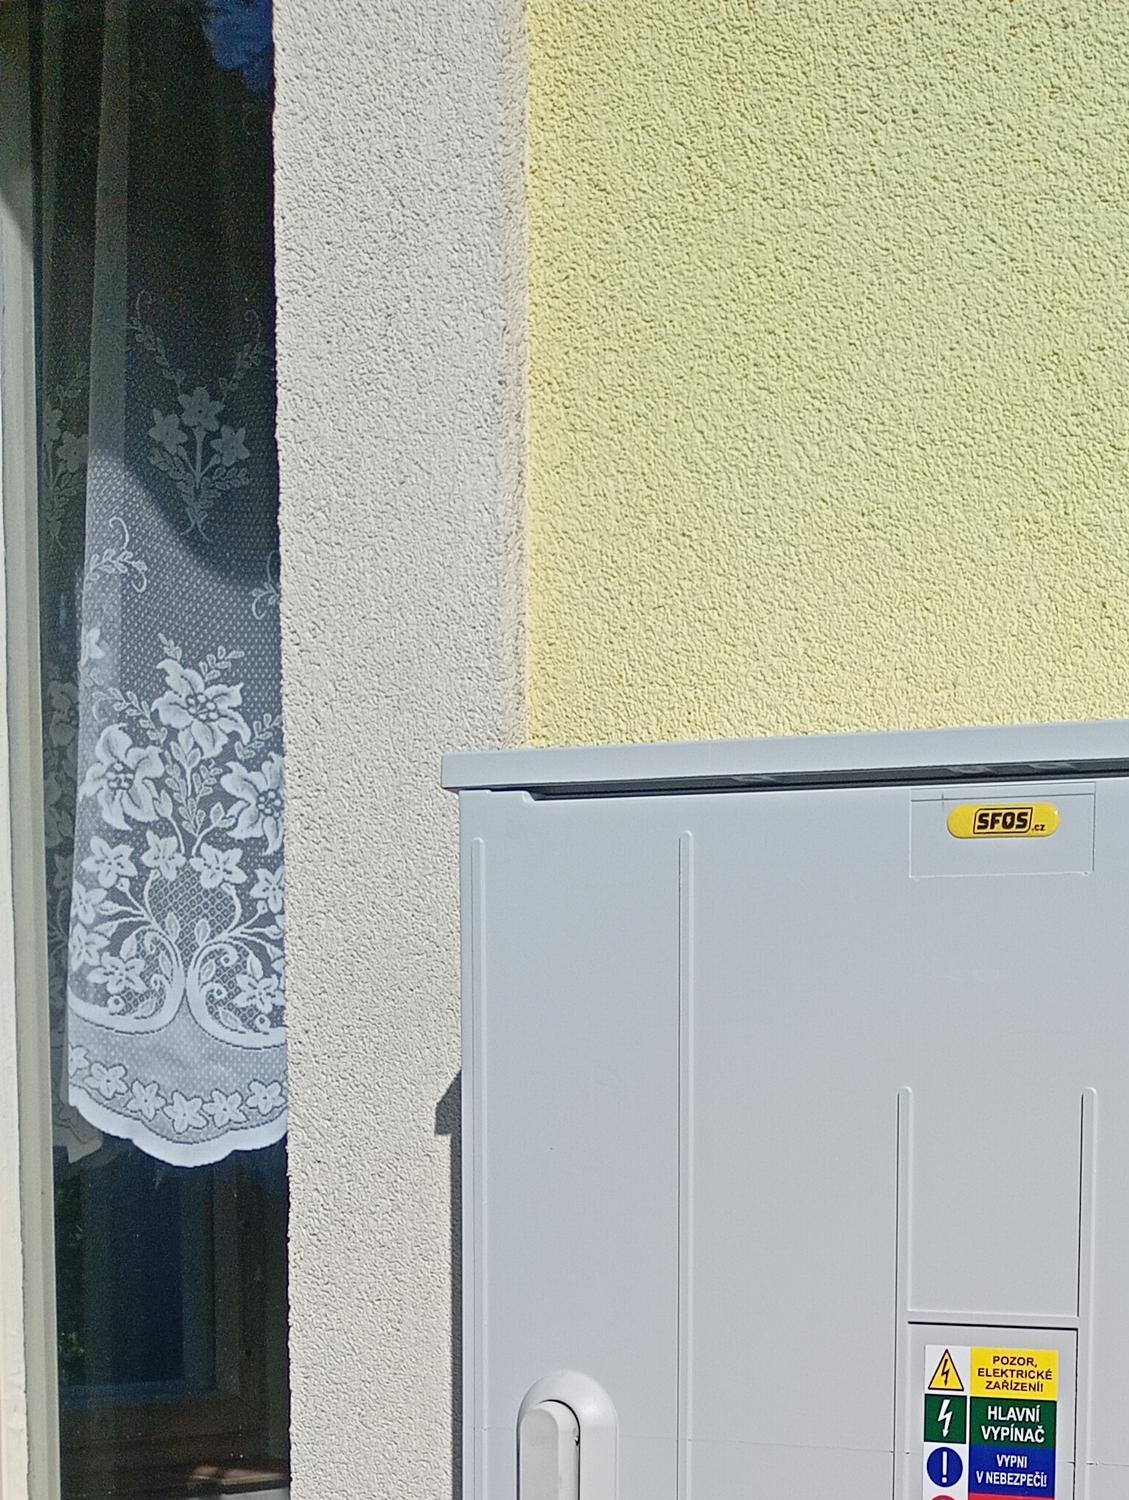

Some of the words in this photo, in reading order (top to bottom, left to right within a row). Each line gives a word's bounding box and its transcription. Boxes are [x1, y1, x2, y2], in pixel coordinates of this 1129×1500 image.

[992, 1355, 1038, 1368] POZOR,
[977, 1367, 1053, 1380] ELEKTRICKÉ
[985, 1379, 1044, 1393] ZAŘÍZENÍ!
[987, 1404, 1041, 1423] HLAVNÍ
[981, 1424, 1045, 1444] VYPÍNAČ
[996, 1454, 1028, 1468] VYPNI
[976, 1470, 984, 1484] V
[985, 1471, 1047, 1487] NEBEZPEČÍ!
